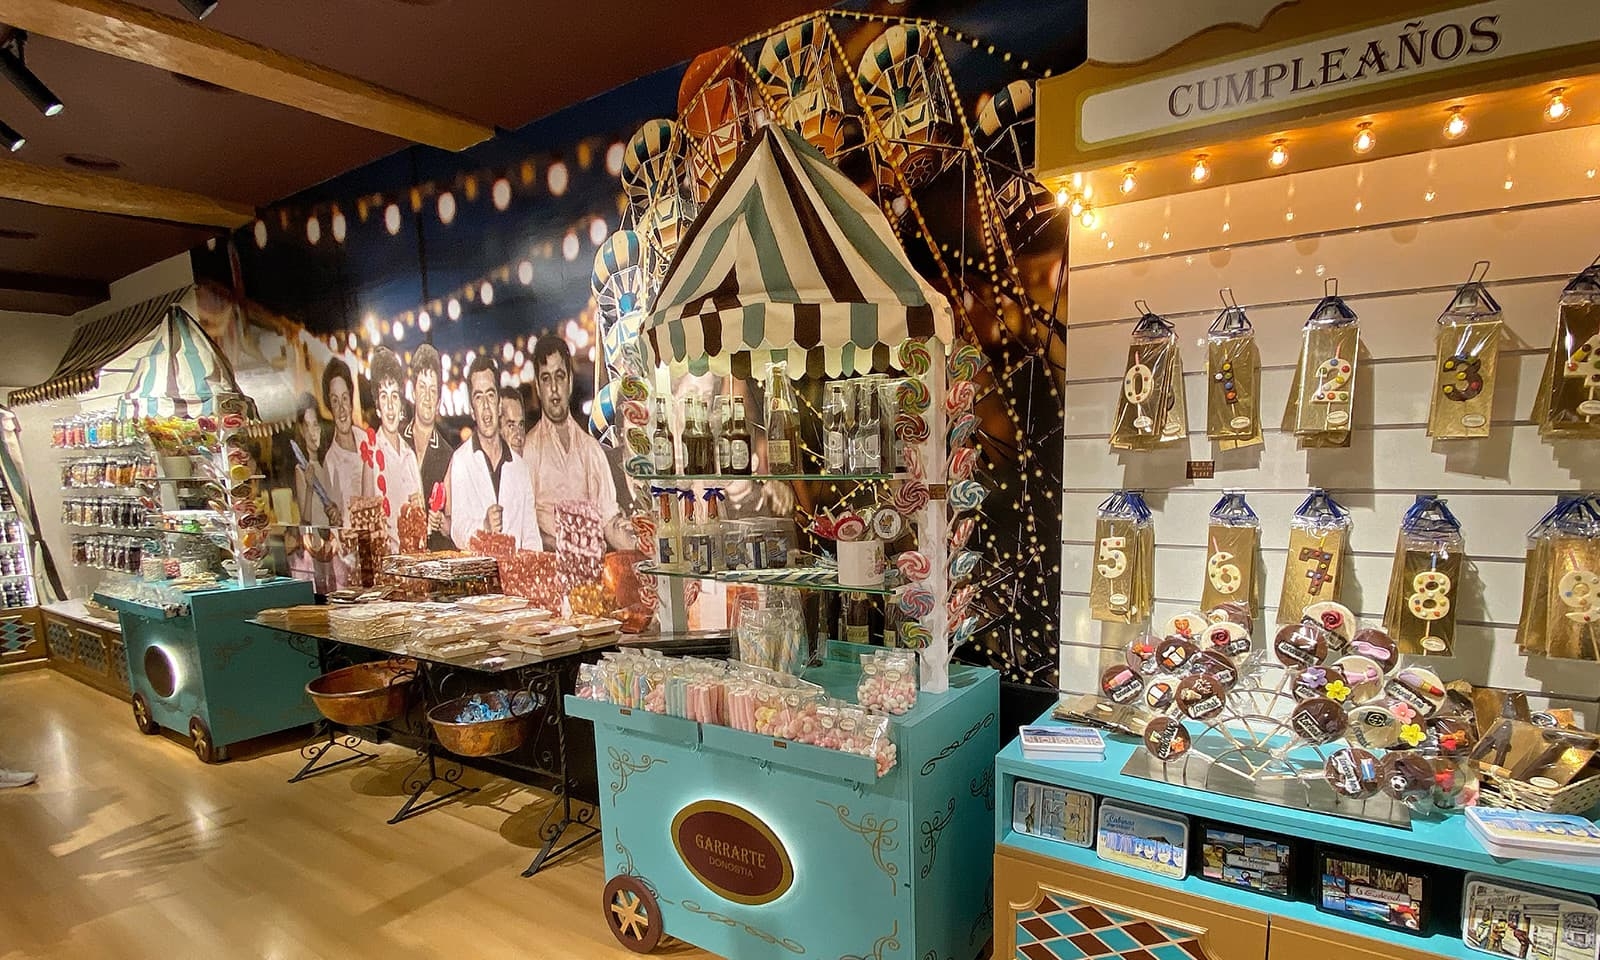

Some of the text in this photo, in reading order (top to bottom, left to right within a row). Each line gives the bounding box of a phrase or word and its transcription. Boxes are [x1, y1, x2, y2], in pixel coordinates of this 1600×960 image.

[1168, 14, 1502, 118] CUMPLEAÑOS
[695, 833, 767, 869] GARRARTE
[709, 856, 754, 879] DONOSTIA
